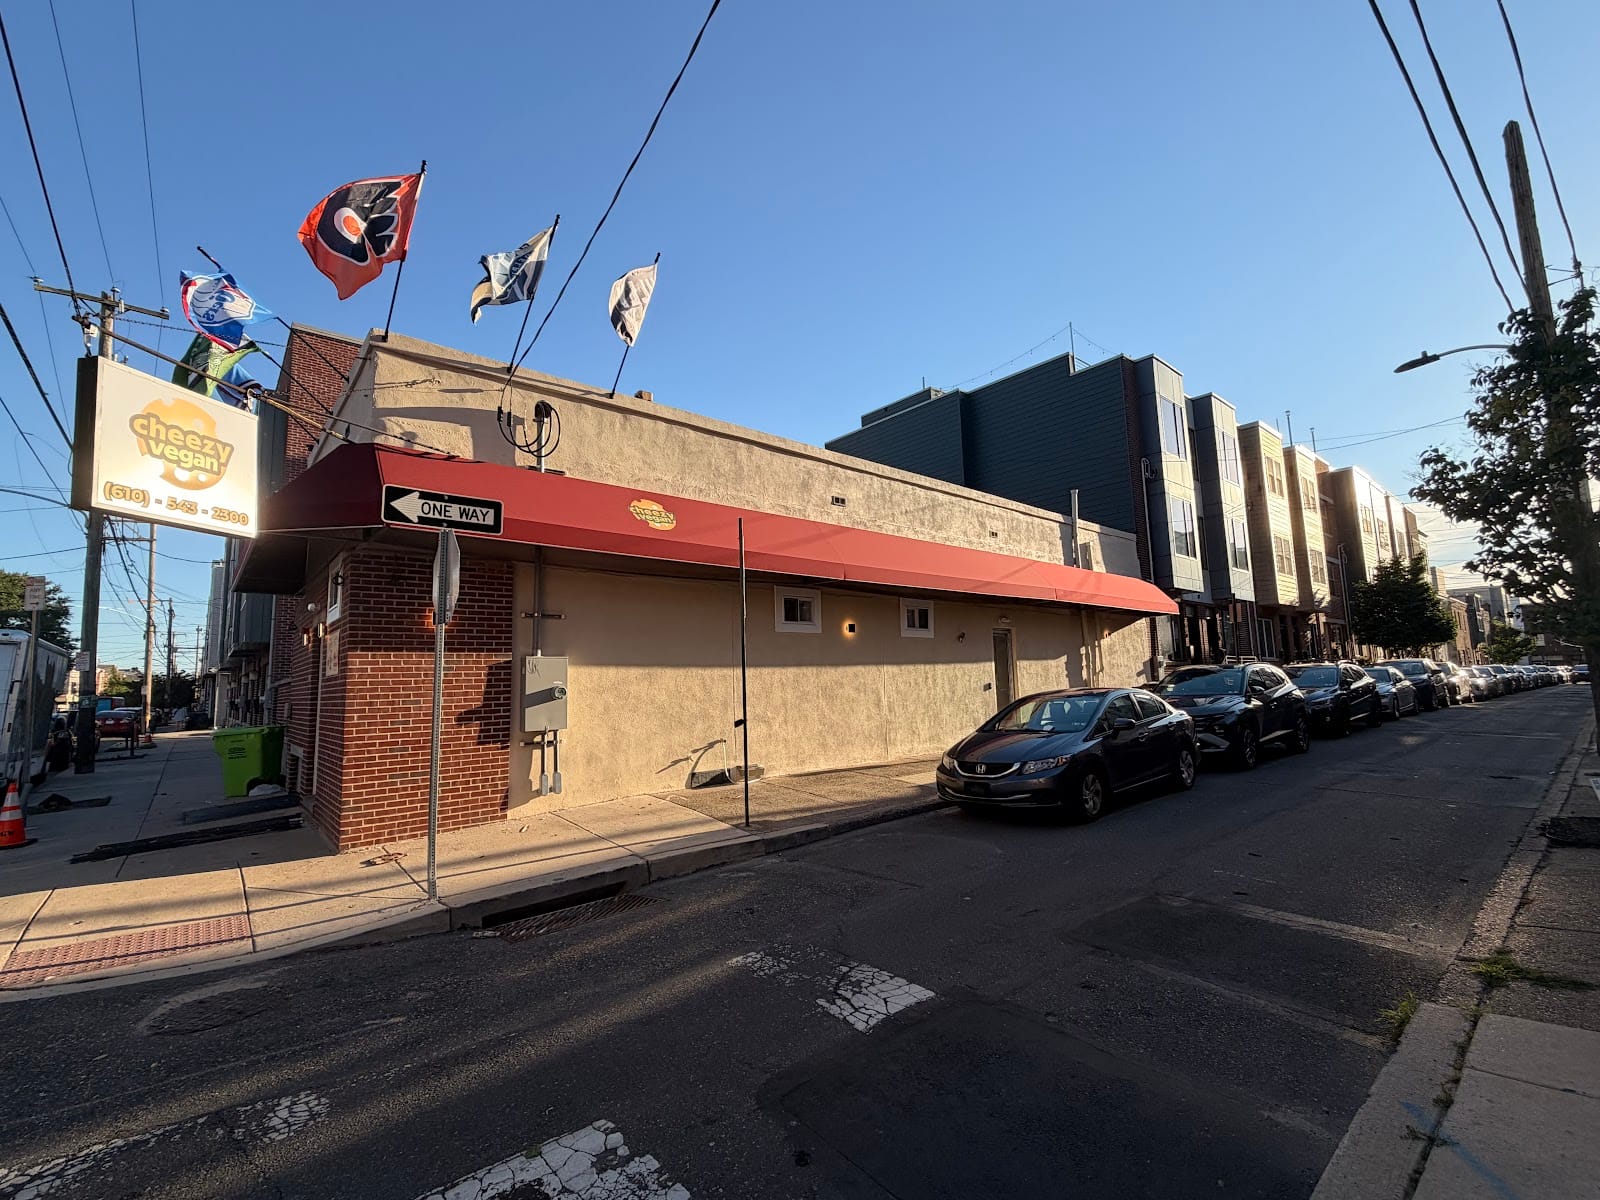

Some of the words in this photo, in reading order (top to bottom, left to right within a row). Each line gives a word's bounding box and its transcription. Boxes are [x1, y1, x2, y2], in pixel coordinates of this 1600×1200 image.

[131, 414, 233, 464] cheezy
[148, 438, 220, 473] vegan
[103, 482, 150, 507] (610)
[165, 496, 198, 515] 543
[211, 506, 249, 526] 2300
[421, 501, 452, 518] ONE
[459, 506, 490, 522] WAY
